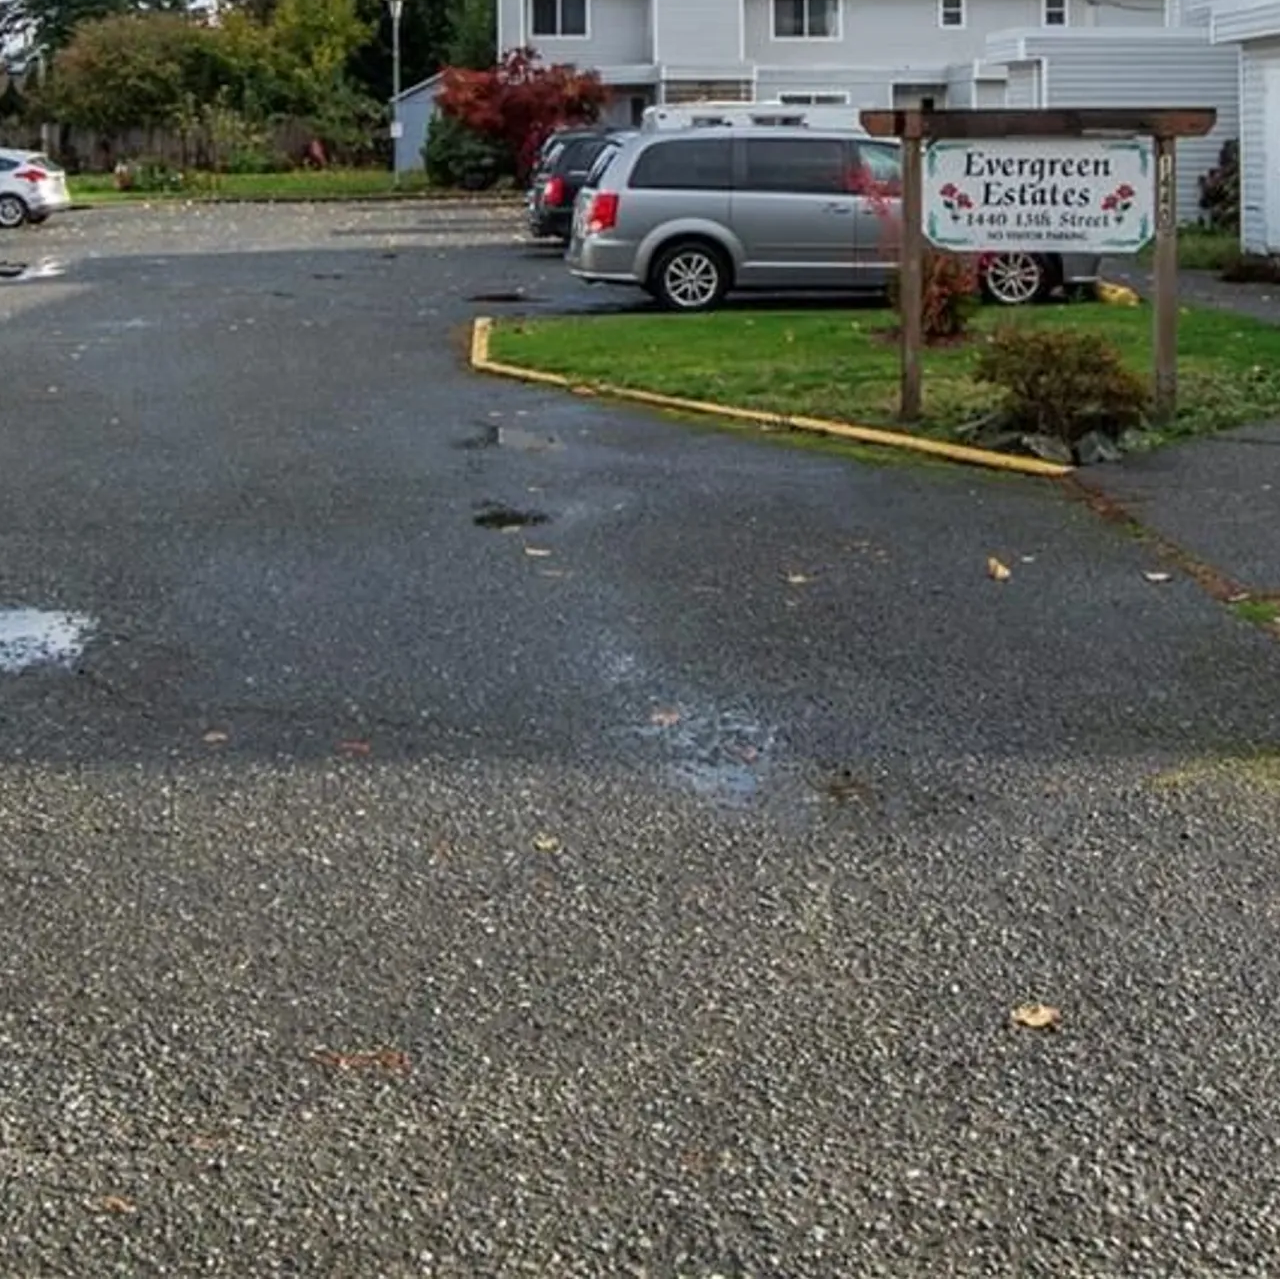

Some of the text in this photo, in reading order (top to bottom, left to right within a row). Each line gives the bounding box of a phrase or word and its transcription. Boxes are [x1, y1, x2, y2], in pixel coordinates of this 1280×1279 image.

[965, 151, 1111, 180] Evergreen
[982, 181, 1091, 206] Estates
[966, 210, 1110, 227] 1440 13th Street
